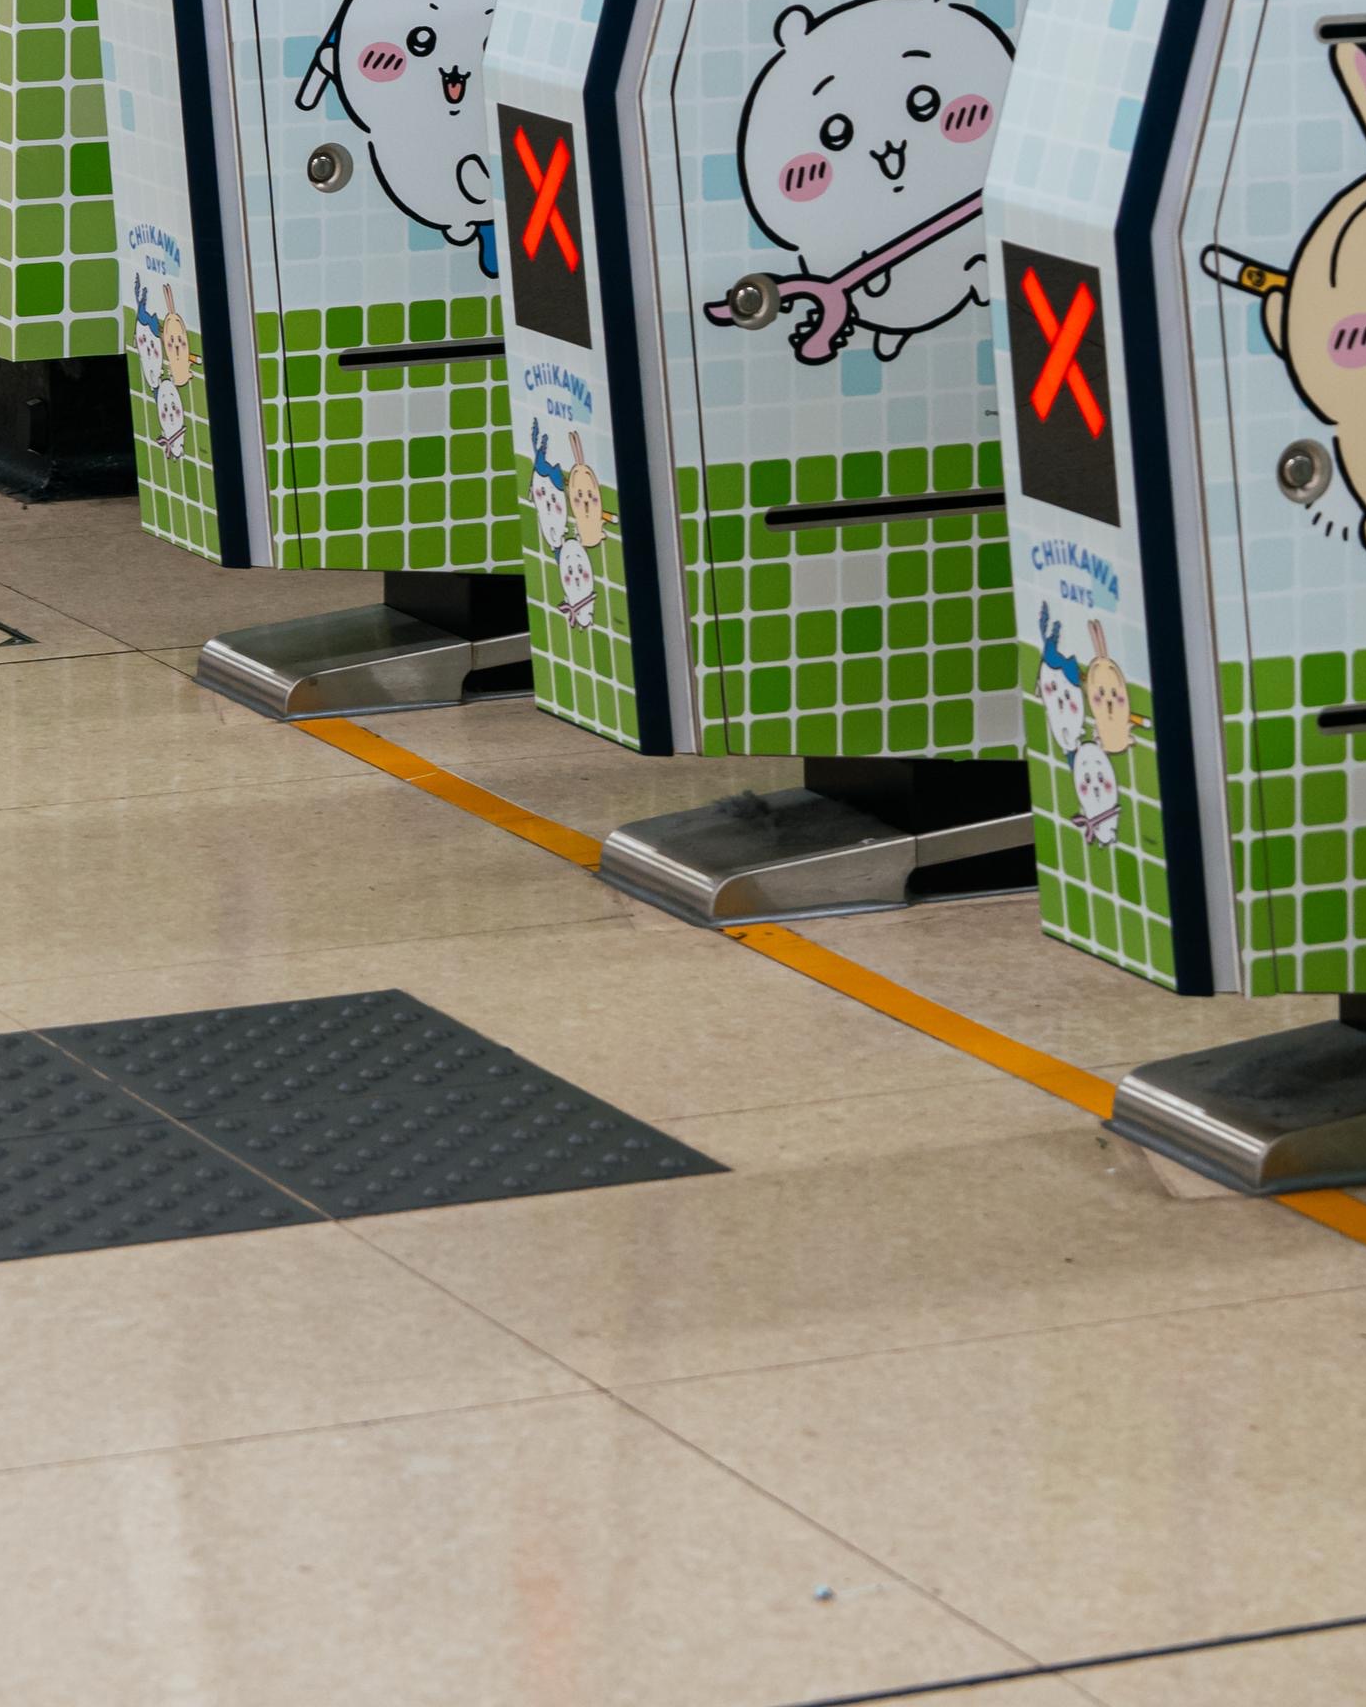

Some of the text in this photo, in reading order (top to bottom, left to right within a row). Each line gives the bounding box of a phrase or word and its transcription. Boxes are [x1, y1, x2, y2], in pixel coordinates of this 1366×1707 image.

[145, 254, 166, 276] DAYS
[546, 397, 573, 422] DAYS
[1059, 578, 1094, 609] DAYS
